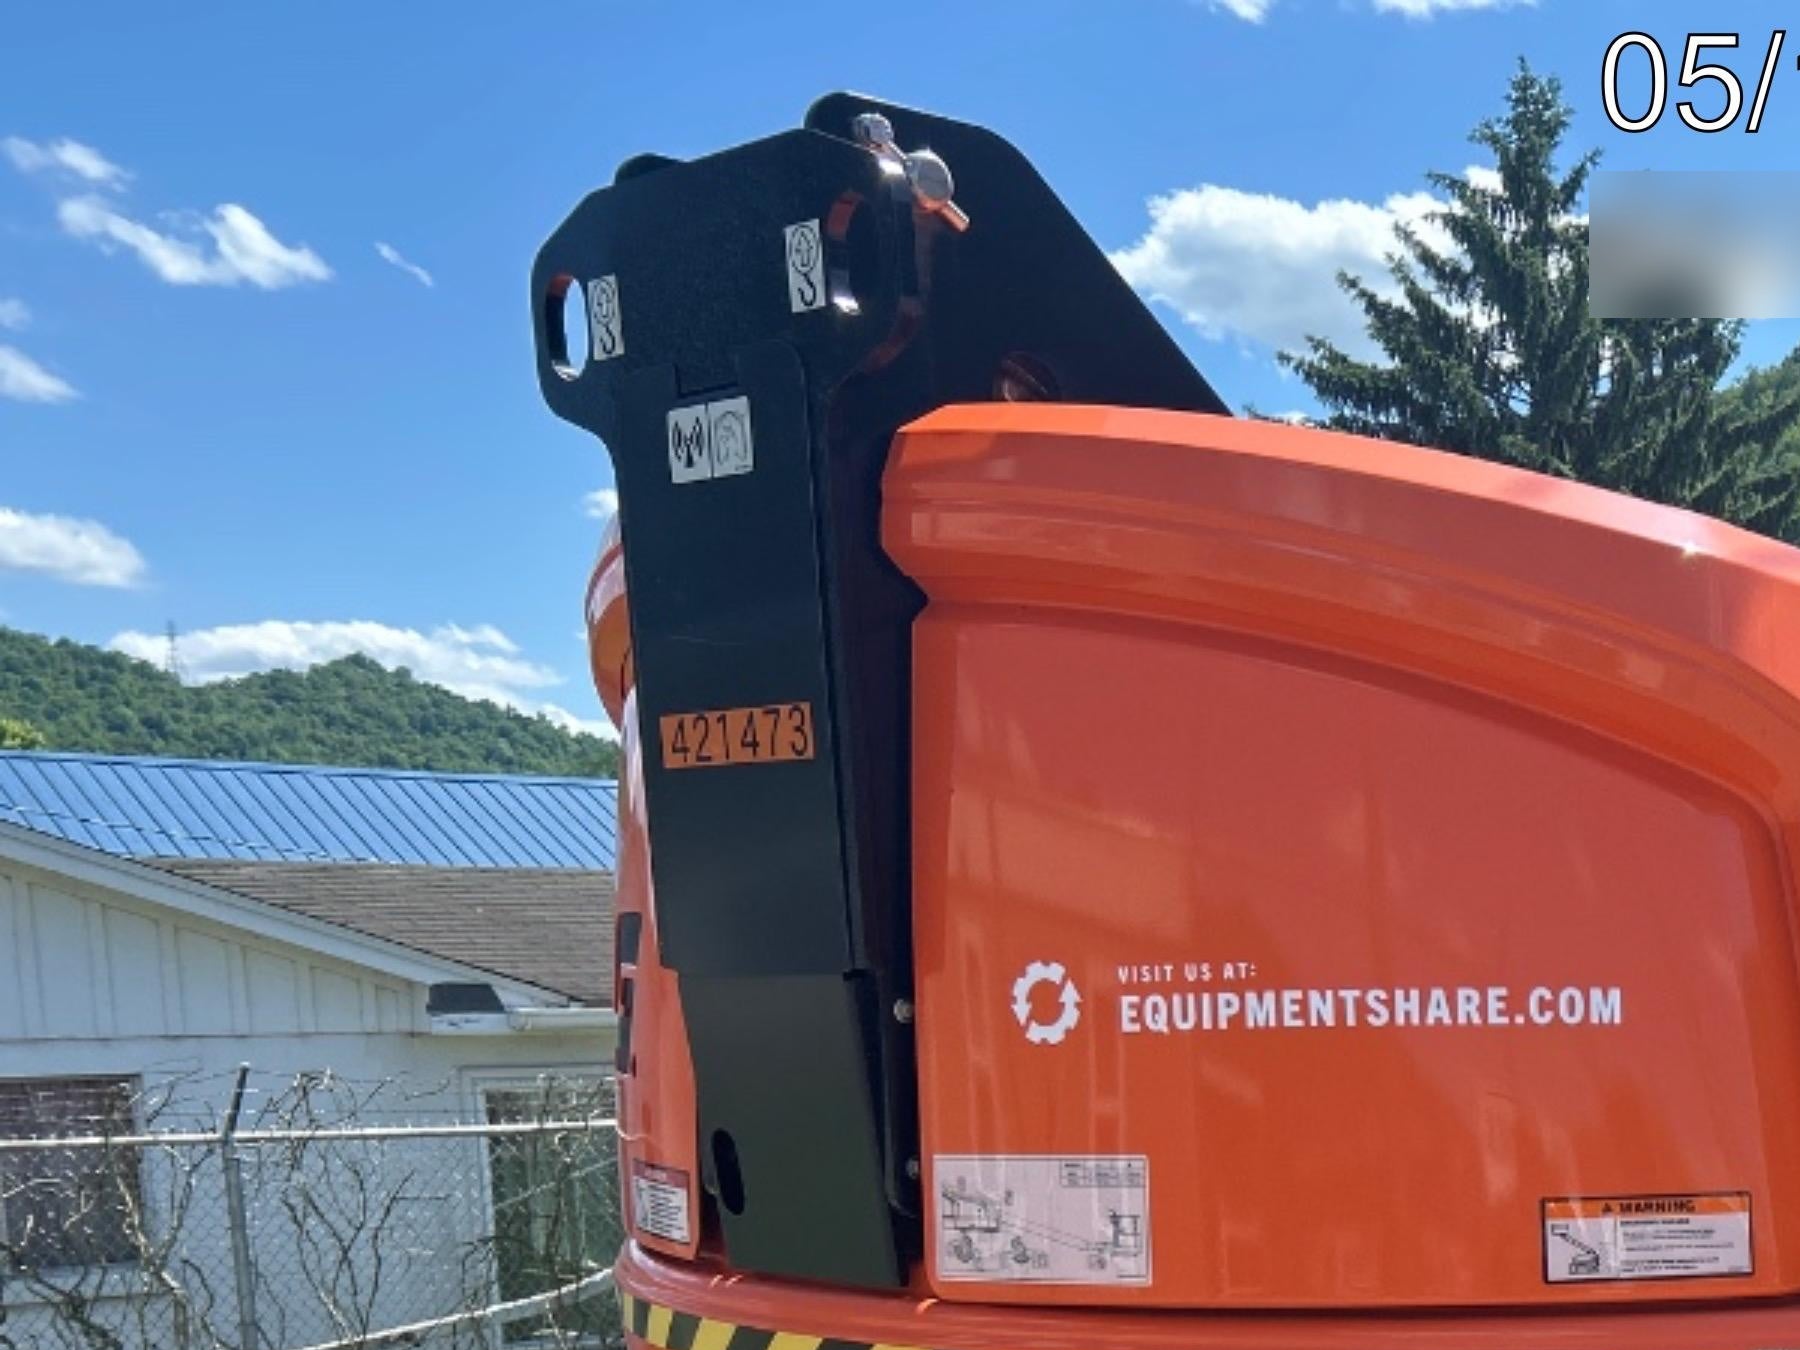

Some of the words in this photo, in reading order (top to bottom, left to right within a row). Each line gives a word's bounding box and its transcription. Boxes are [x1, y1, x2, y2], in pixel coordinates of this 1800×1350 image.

[671, 704, 808, 763] 421473
[1117, 964, 1174, 984] VISIT
[1184, 962, 1213, 983] US
[1223, 962, 1257, 981] AT:
[1119, 986, 1623, 1033] EQUIPMENTSHARE.COM
